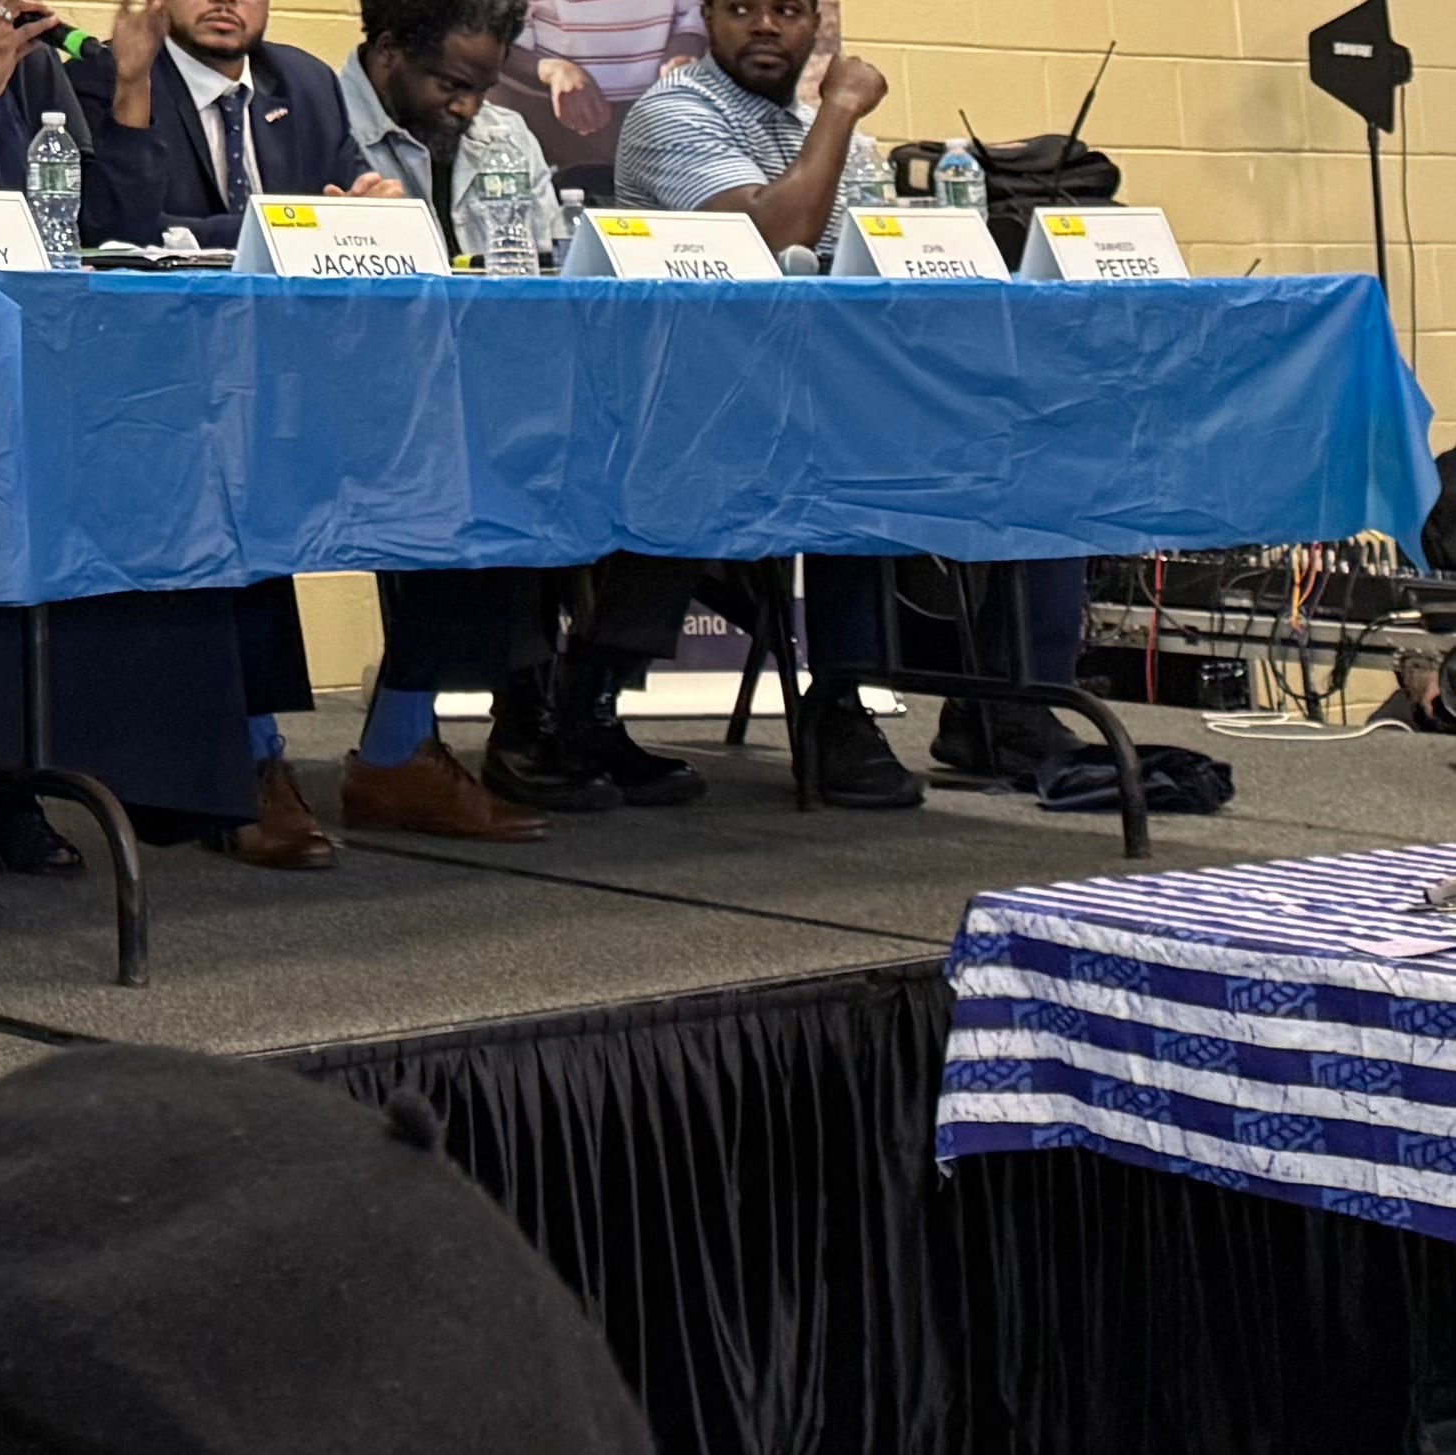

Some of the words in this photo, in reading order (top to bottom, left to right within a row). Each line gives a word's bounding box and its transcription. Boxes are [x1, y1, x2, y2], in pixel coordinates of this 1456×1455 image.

[312, 254, 417, 276] JACKSON
[664, 260, 734, 280] NIVAR
[905, 260, 979, 279] FARRELL
[1095, 256, 1160, 277] PETERS
